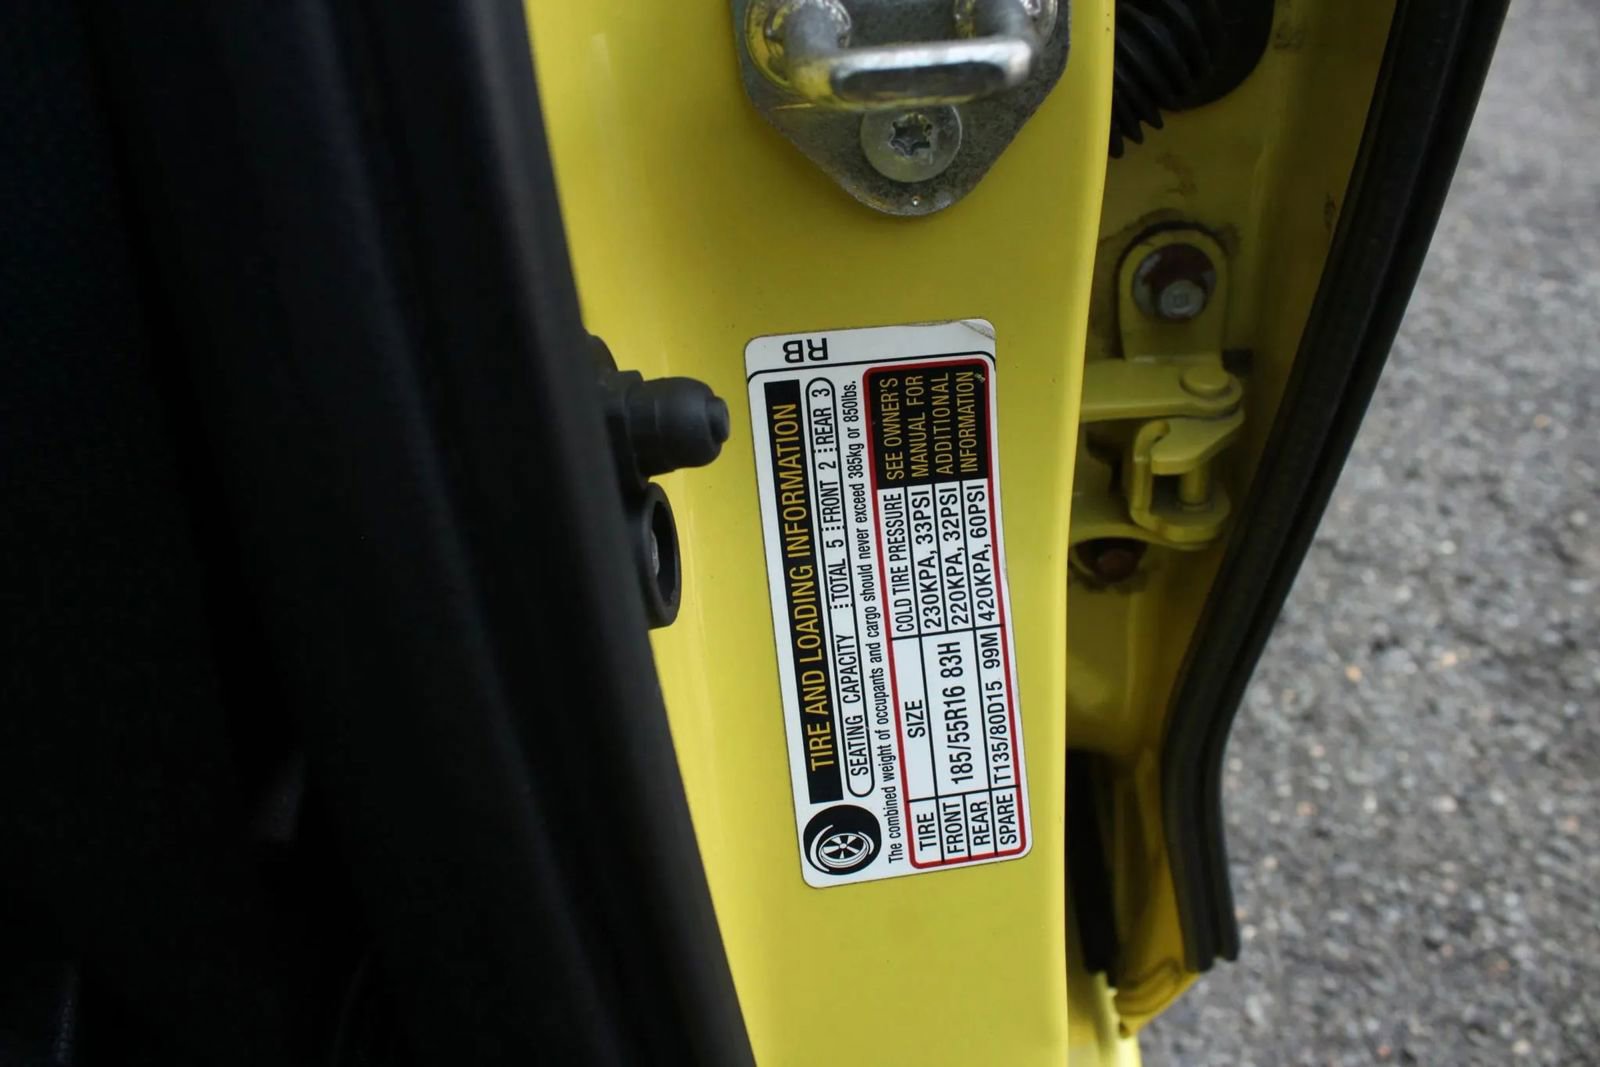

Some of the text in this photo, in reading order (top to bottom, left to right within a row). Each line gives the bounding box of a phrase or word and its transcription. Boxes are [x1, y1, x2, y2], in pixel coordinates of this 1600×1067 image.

[783, 338, 828, 363] RB
[879, 378, 904, 480] SEE OWNER'S
[905, 376, 929, 477] MANUAL FOR
[930, 373, 953, 475] ADDITIONAL
[955, 372, 978, 472] INFORMATION
[772, 404, 834, 771] TIRE AND LOADING INFORMATION
[811, 388, 869, 776] SEATING CAPACITY TOTAL 5 FRONT 2 REAR 3
[883, 493, 914, 632] COLD TIRE PRESSURE
[911, 490, 941, 629] 230KPA, 33PSI
[939, 488, 969, 625] 220KPA, 32PSI
[966, 485, 995, 621] 420KPA, 60PSI
[841, 381, 904, 863] The combined weight of occupants and cargo should never exceed 385kg or 850lbs.
[904, 700, 925, 738] SIZE
[937, 642, 973, 784] 185/55R16 83H
[980, 632, 1011, 784] T135/80D15 99M
[917, 812, 937, 851] TIRE
[943, 802, 964, 854] FRONT
[970, 801, 990, 846] REAR
[996, 793, 1017, 845] SPARE
